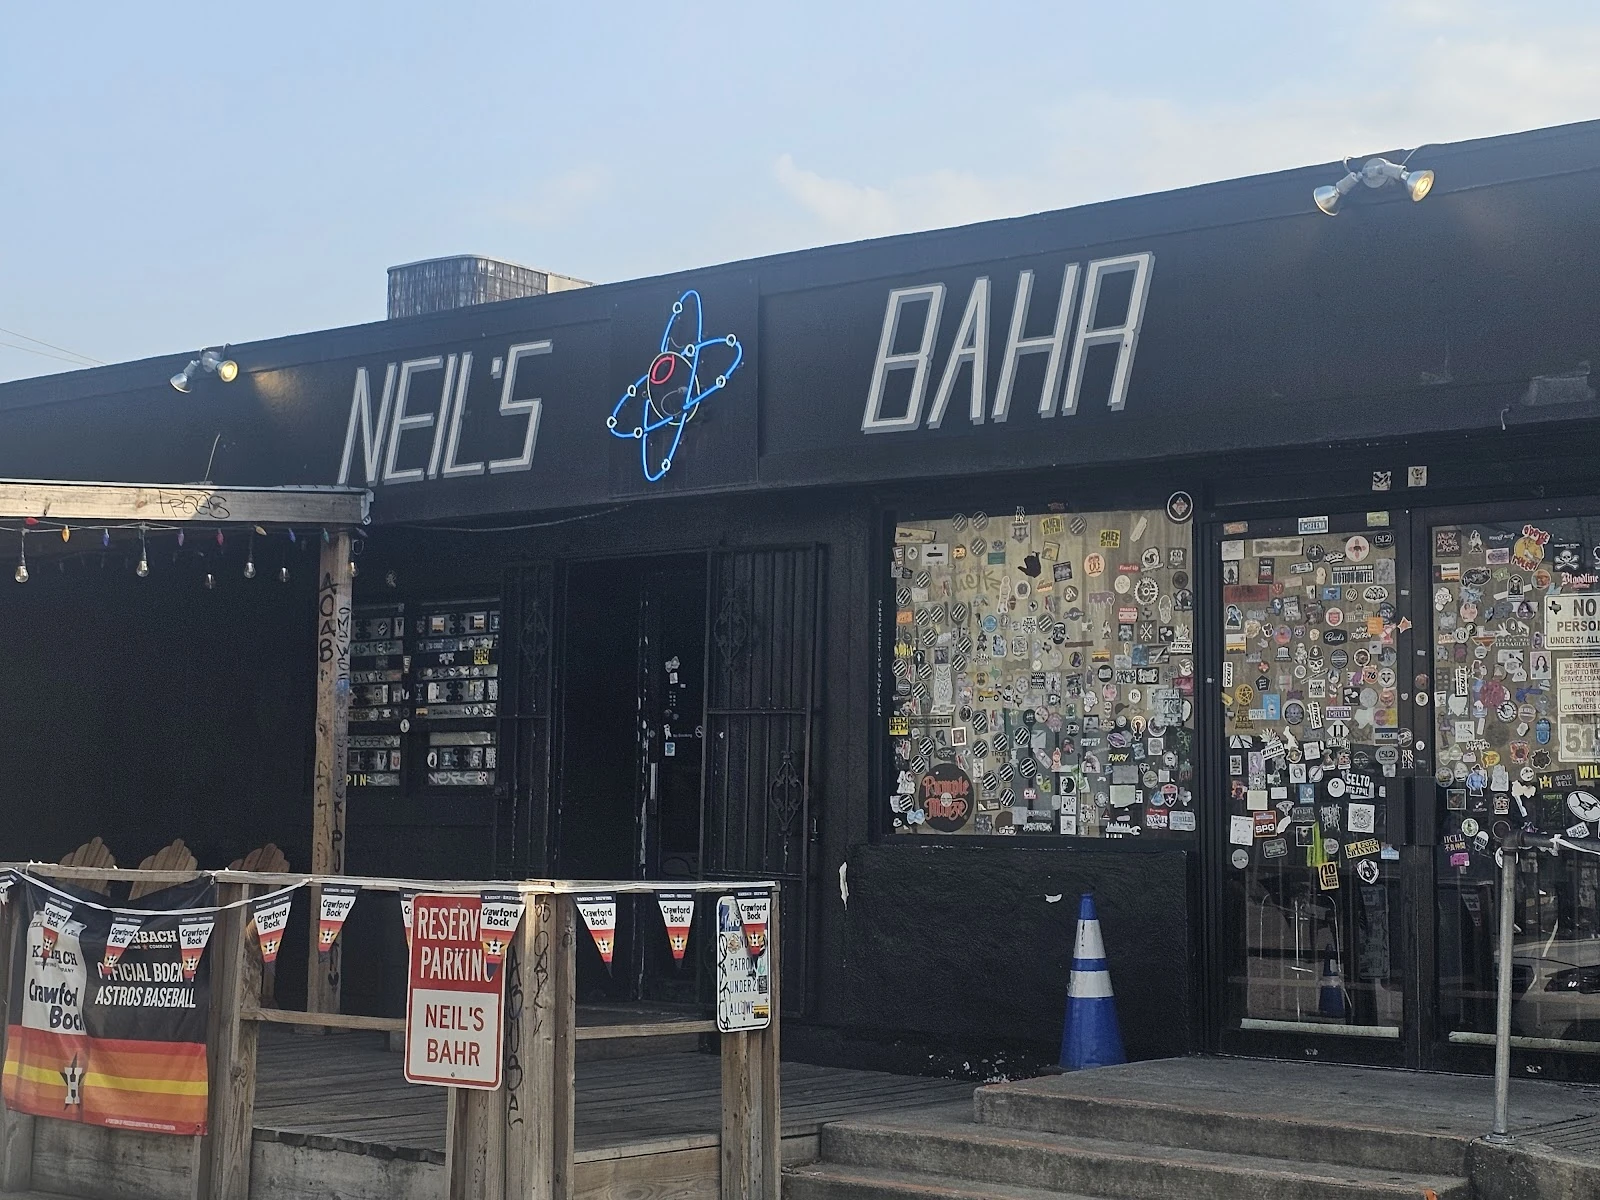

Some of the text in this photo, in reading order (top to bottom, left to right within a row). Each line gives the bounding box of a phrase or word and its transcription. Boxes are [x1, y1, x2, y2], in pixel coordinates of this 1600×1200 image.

[861, 251, 1156, 434] BAHR
[337, 339, 553, 487] NEIL'S
[1561, 572, 1599, 586] Bloodline
[1573, 598, 1597, 617] NO
[1557, 620, 1600, 632] PERSO
[1550, 635, 1600, 645] UNDER 21 ALL
[1367, 671, 1376, 679] 76
[1324, 863, 1336, 875] 10
[322, 899, 351, 909] Crawford
[663, 906, 690, 914] Crawford
[741, 903, 767, 912] Crawford
[45, 907, 68, 922] Crawford
[257, 908, 287, 924] Crawford
[326, 908, 342, 917] Bock
[482, 907, 519, 918] Crawford
[582, 908, 613, 917] Crawford
[747, 911, 761, 920] Bock
[46, 916, 60, 928] Bock
[263, 919, 281, 930] Bock
[417, 906, 480, 942] RESERV
[486, 916, 510, 927] Bock
[591, 918, 608, 926] Bock
[670, 915, 685, 923] Bock
[111, 927, 137, 938] Crawford
[132, 930, 178, 944] RBACH
[181, 927, 210, 937] Crawford
[111, 934, 127, 944] Bock
[187, 936, 202, 945] Bock
[730, 958, 752, 971] PATRO
[97, 962, 152, 982] OFICIAL
[153, 962, 183, 983] BOCK
[729, 980, 752, 994] UNDER
[95, 985, 197, 1008] ASTROS BASEBALL
[729, 1001, 754, 1016] ALLOWE
[425, 1003, 485, 1032] NEIL'S
[426, 1038, 481, 1067] BAHR
